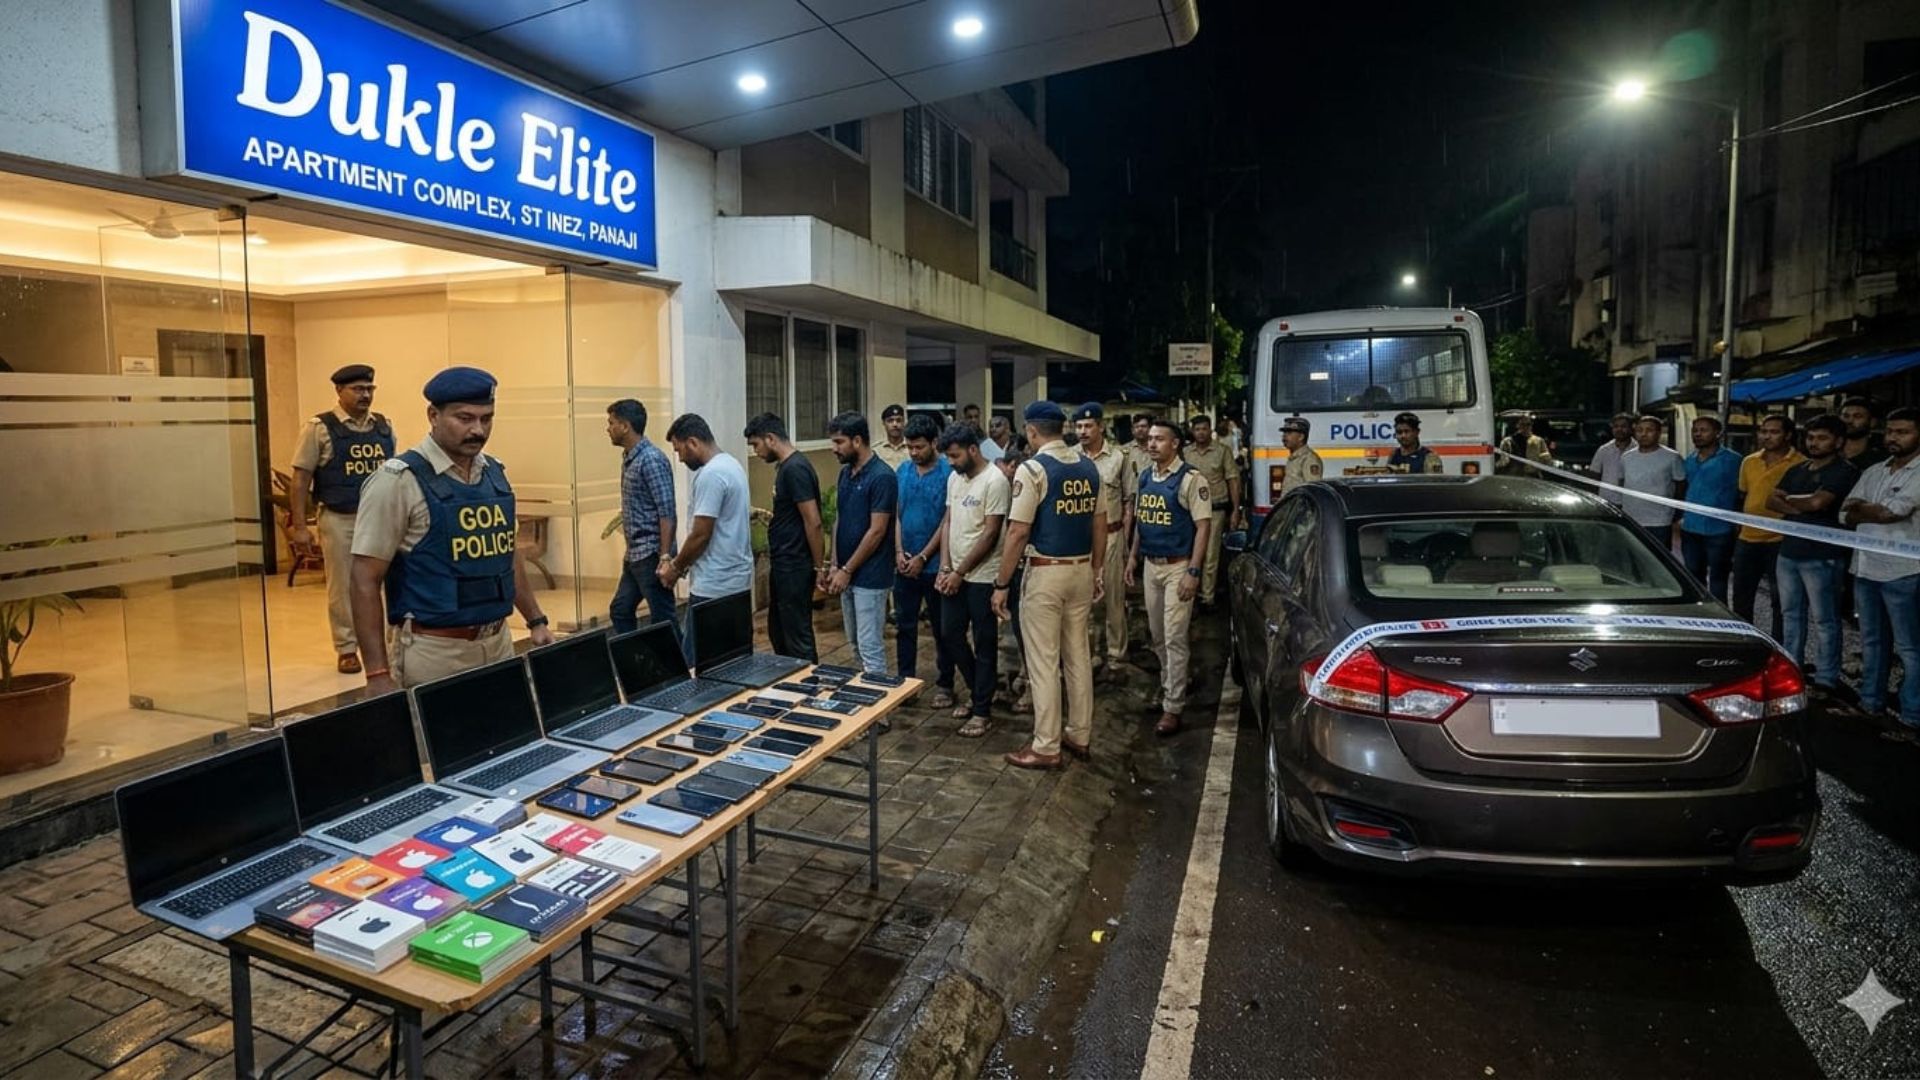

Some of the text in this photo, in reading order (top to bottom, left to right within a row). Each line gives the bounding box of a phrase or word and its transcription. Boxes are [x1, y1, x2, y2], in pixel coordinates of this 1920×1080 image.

[237, 11, 637, 214] Dukle Elite
[243, 137, 638, 251] APARTMENT COMPLEX, ST INEZ, PANAJI
[1331, 423, 1396, 440] POLIC
[350, 443, 385, 458] GOA
[345, 459, 385, 475] POLI
[1063, 479, 1092, 496] GOA
[459, 504, 508, 531] GOA
[452, 530, 515, 561] POLICE
